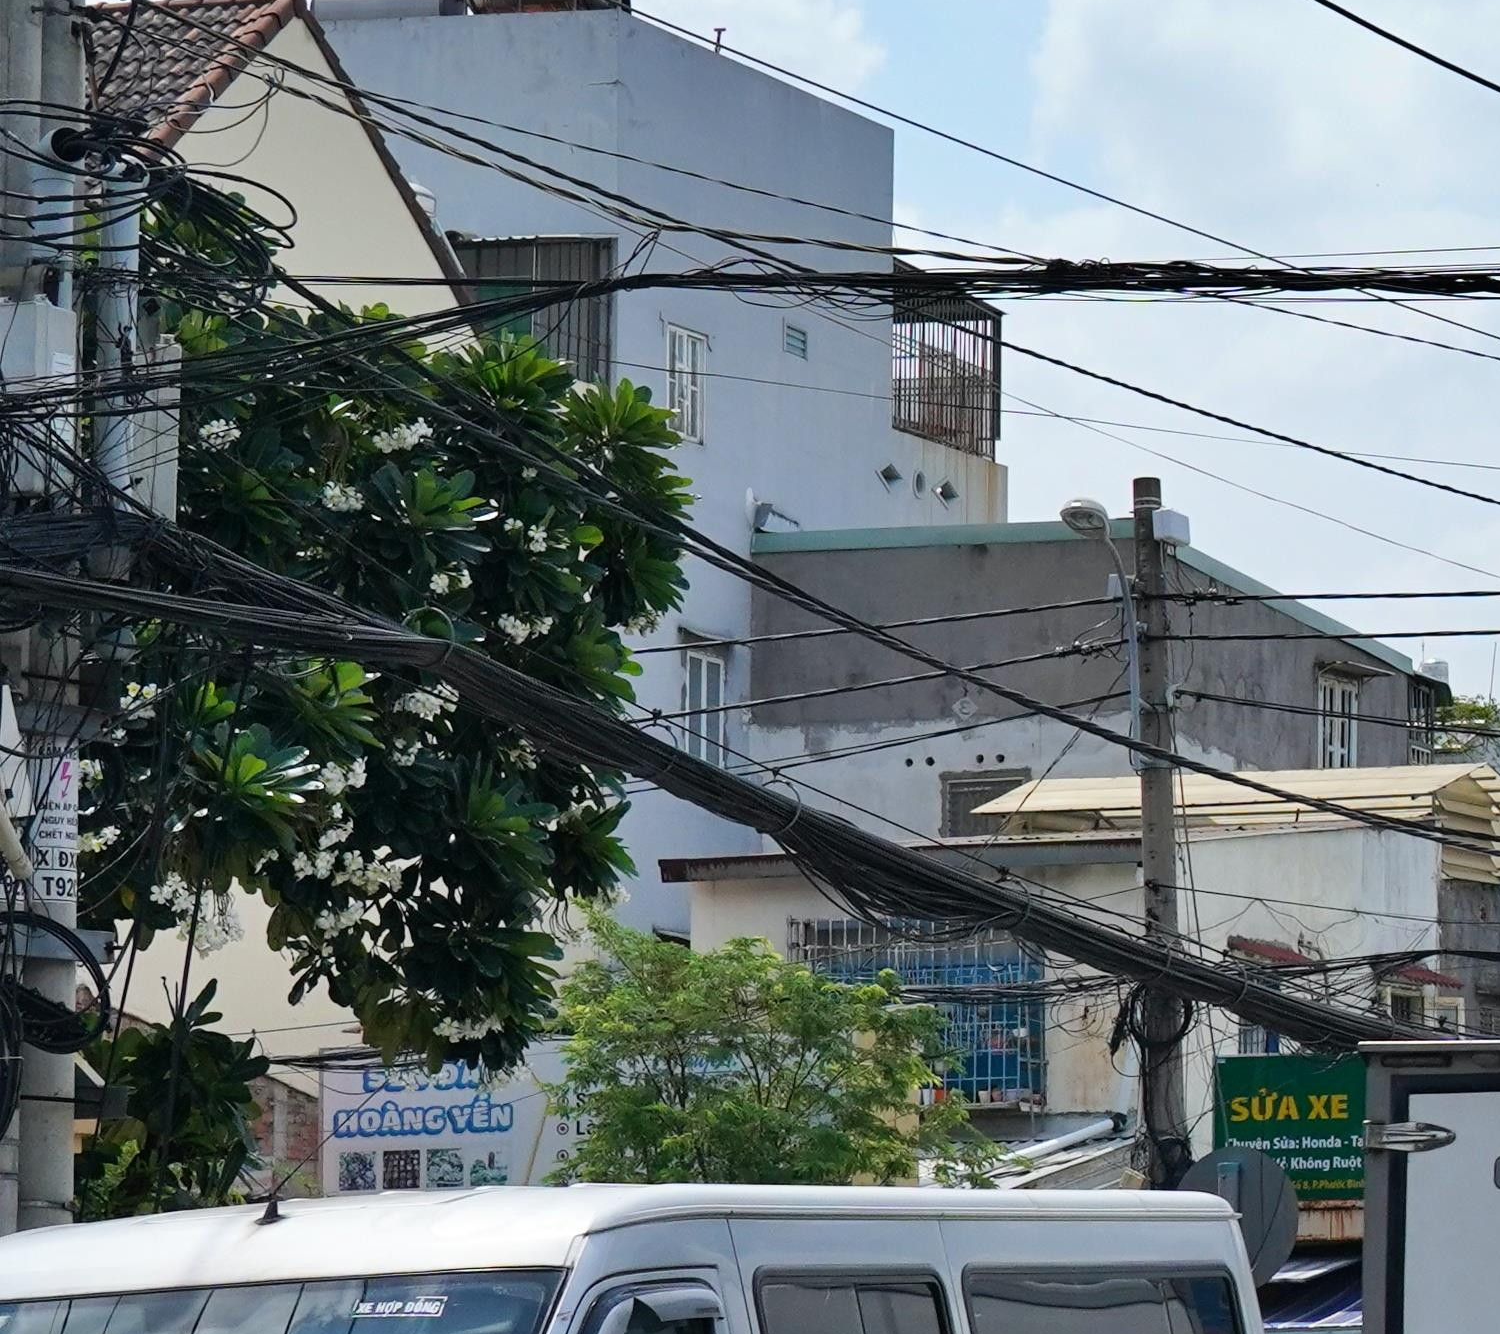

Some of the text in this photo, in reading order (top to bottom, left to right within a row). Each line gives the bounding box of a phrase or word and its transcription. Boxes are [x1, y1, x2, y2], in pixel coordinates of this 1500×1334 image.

[332, 1092, 514, 1139] HOÀNG YẾN
[1229, 1087, 1350, 1123] SỬA XE
[1273, 1135, 1341, 1150] Sửa: Honda
[1290, 1155, 1362, 1171] Không Ruột
[356, 1296, 442, 1317] XE HỢP ĐỒNG
